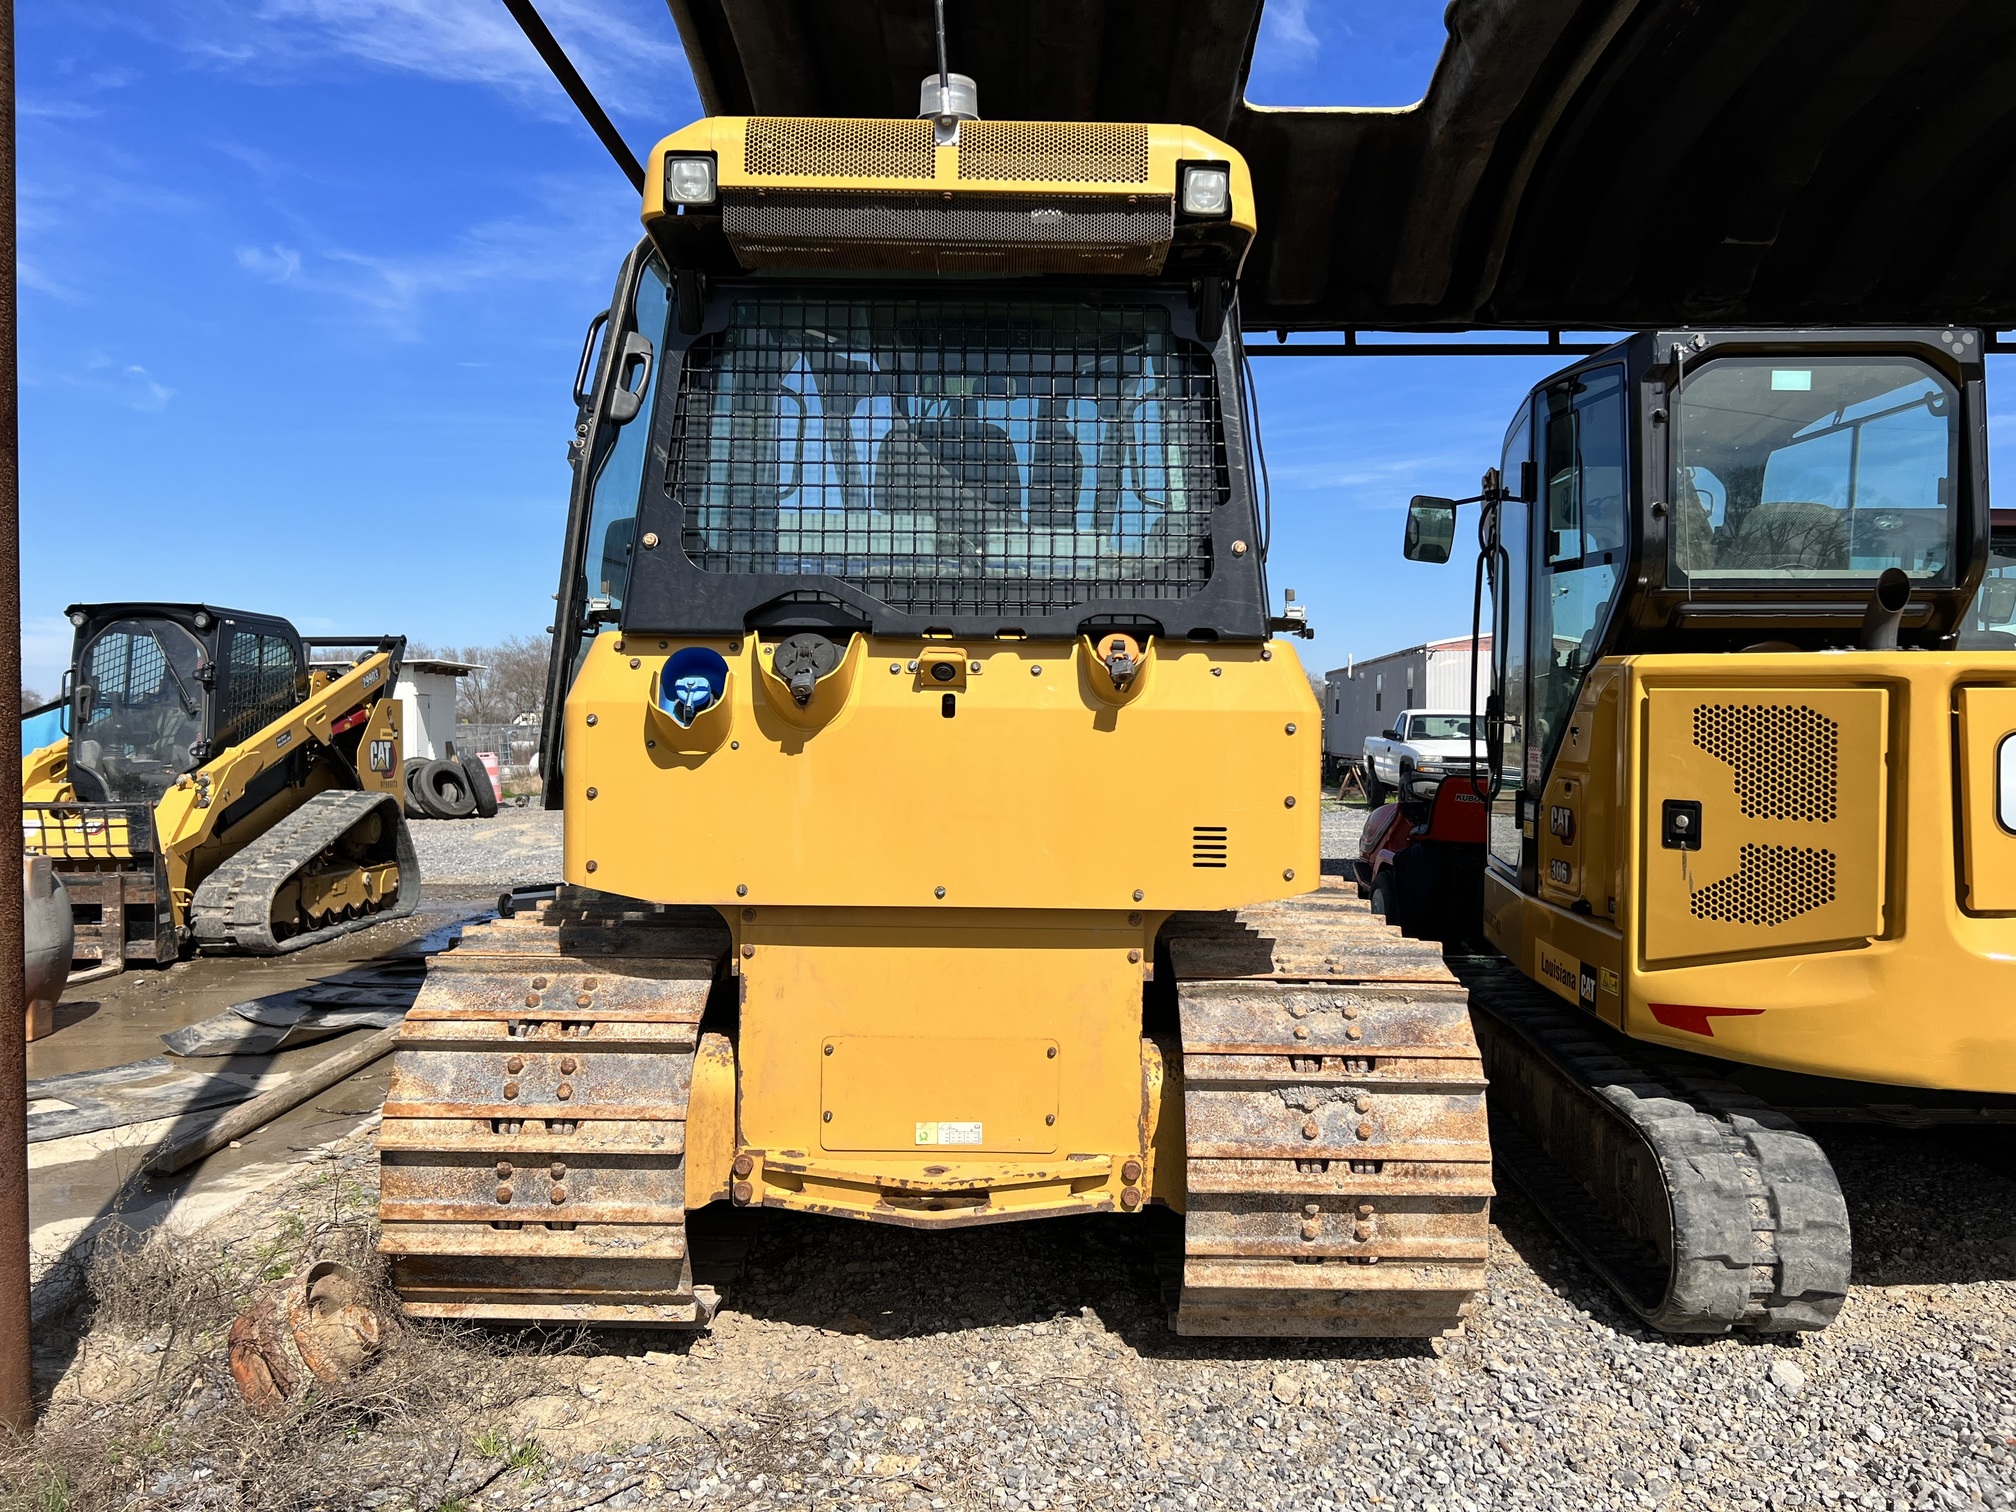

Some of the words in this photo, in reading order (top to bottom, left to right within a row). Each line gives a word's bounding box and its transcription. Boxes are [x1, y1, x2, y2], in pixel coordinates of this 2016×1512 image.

[370, 741, 391, 771] CAT
[1455, 793, 1485, 803] KUBO
[1551, 806, 1571, 836] CAT
[1551, 859, 1568, 882] 306
[1541, 952, 1576, 991] Louisiana
[1581, 974, 1596, 1002] CAT
